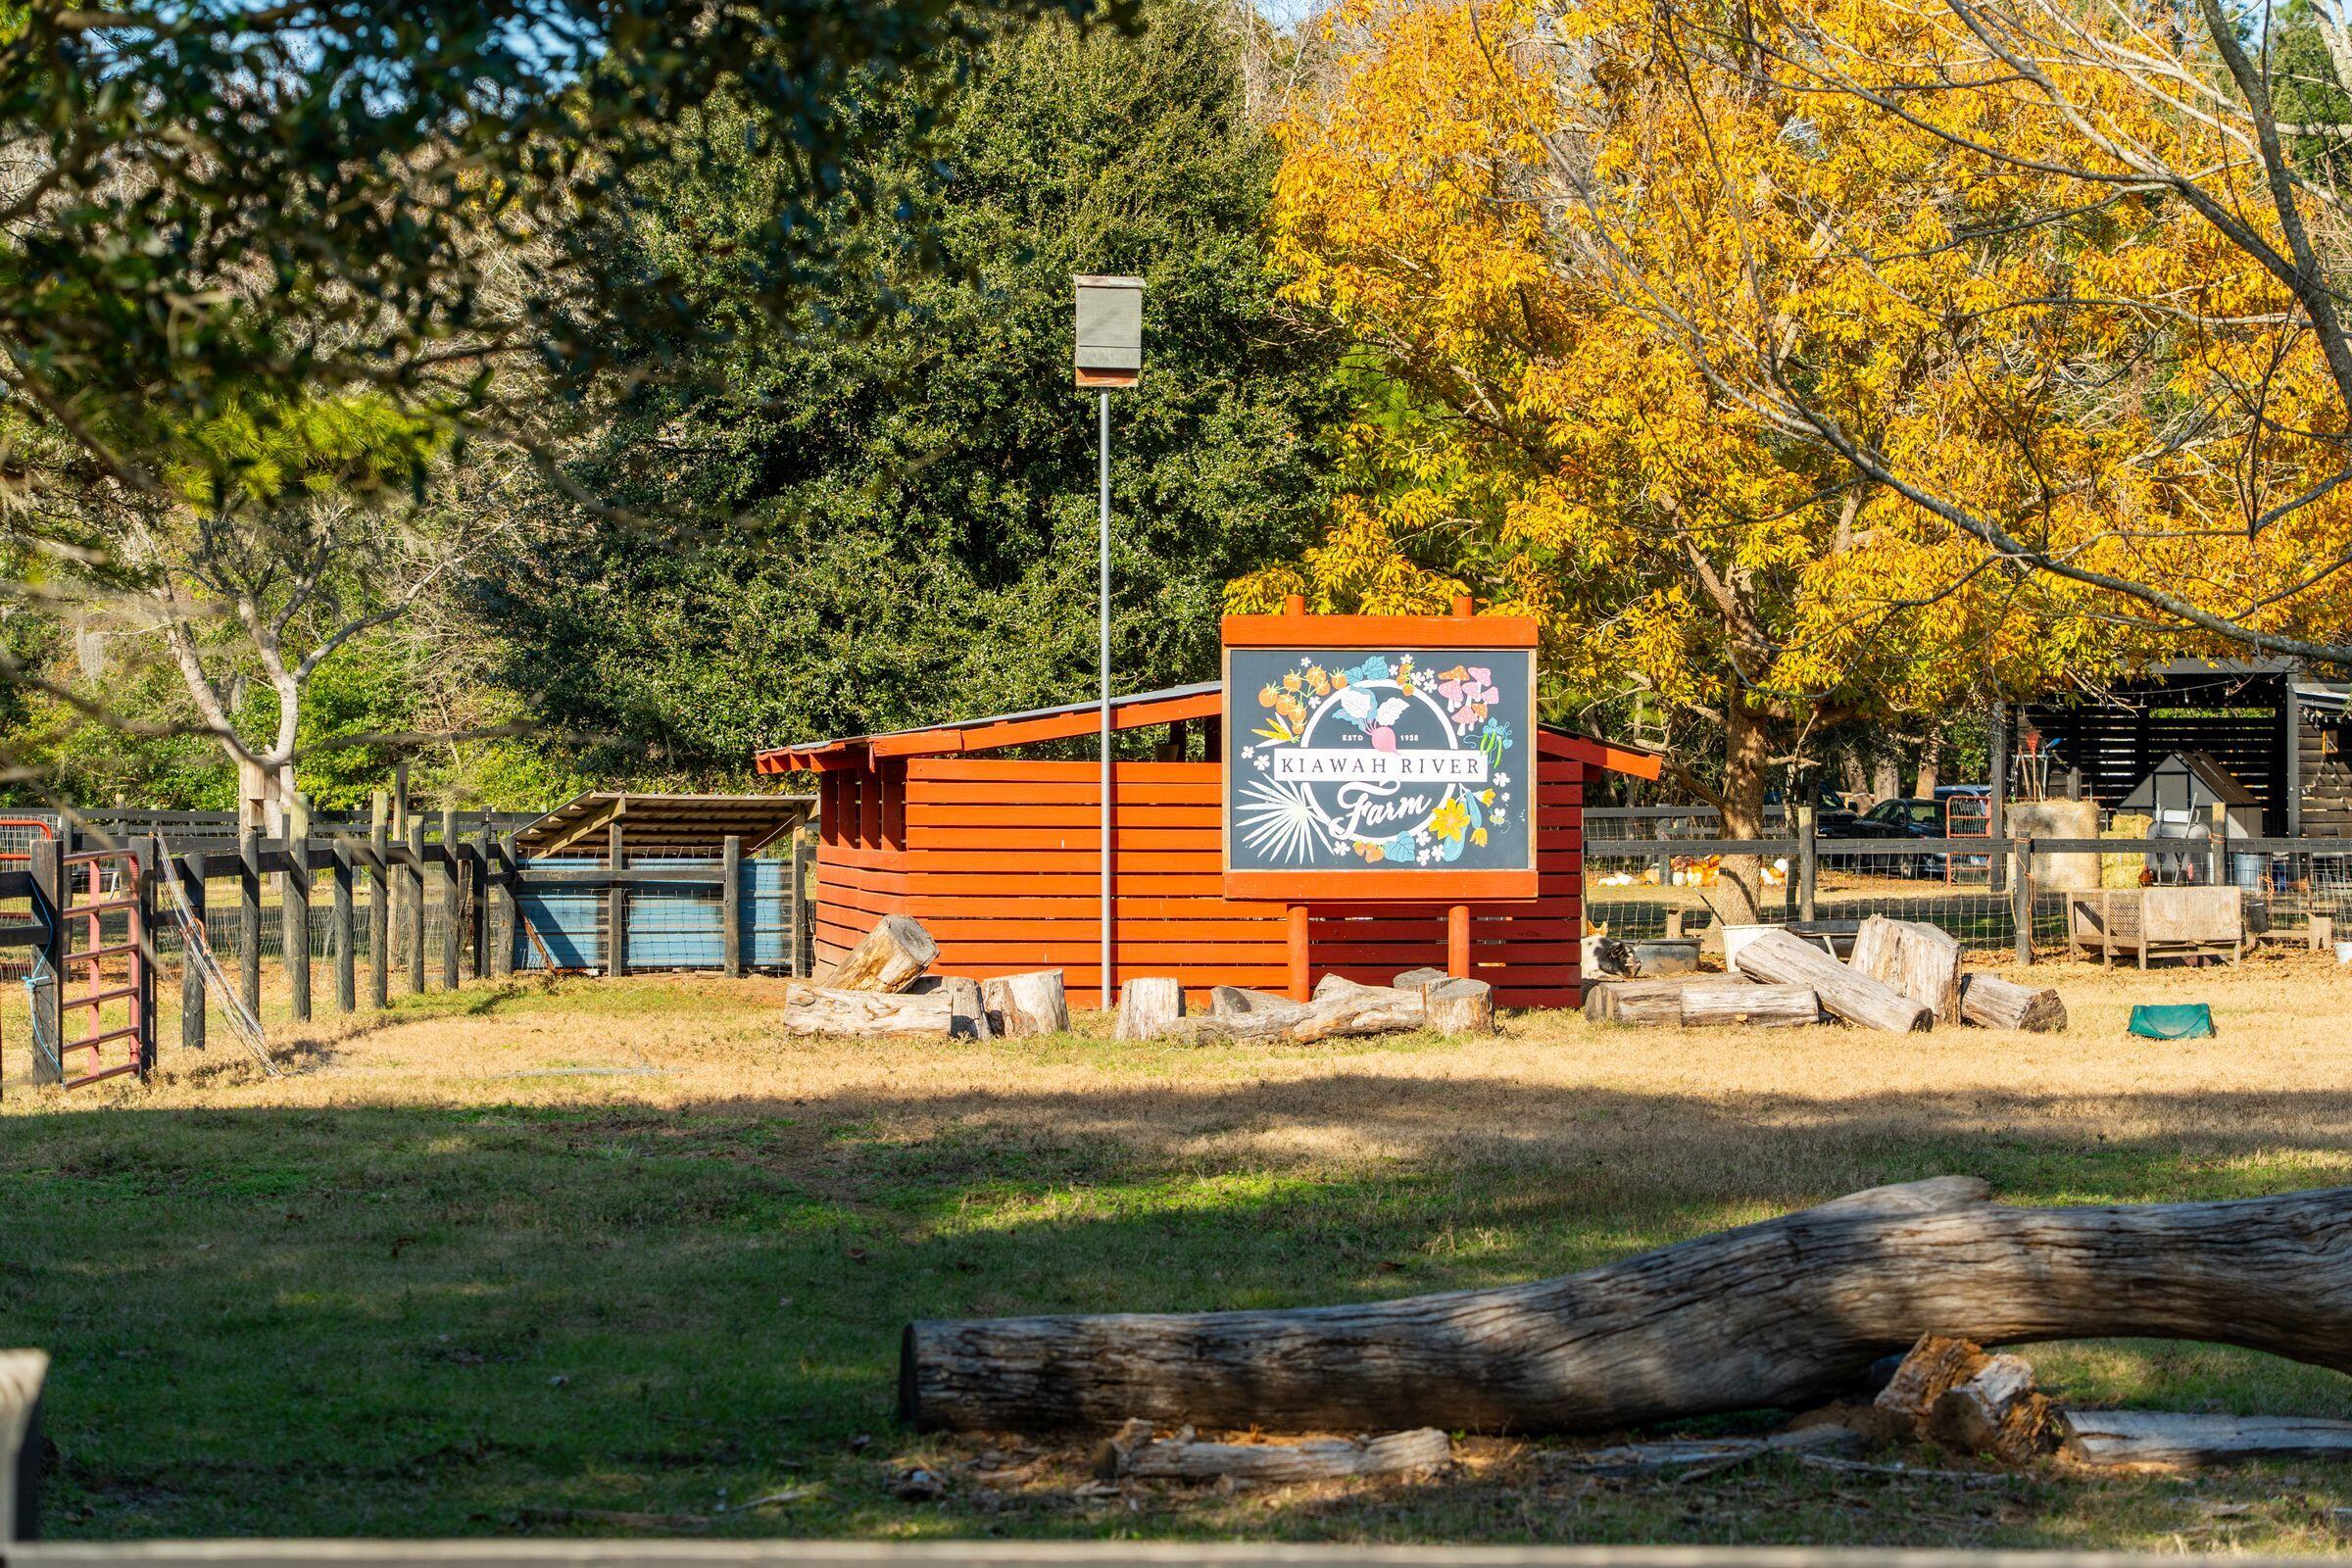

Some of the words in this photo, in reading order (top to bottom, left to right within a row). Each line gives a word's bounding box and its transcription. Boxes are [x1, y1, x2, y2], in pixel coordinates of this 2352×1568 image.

[1281, 758, 1387, 774] KIAWAH
[1400, 758, 1480, 774] RIVER
[1328, 777, 1433, 840] Farm
